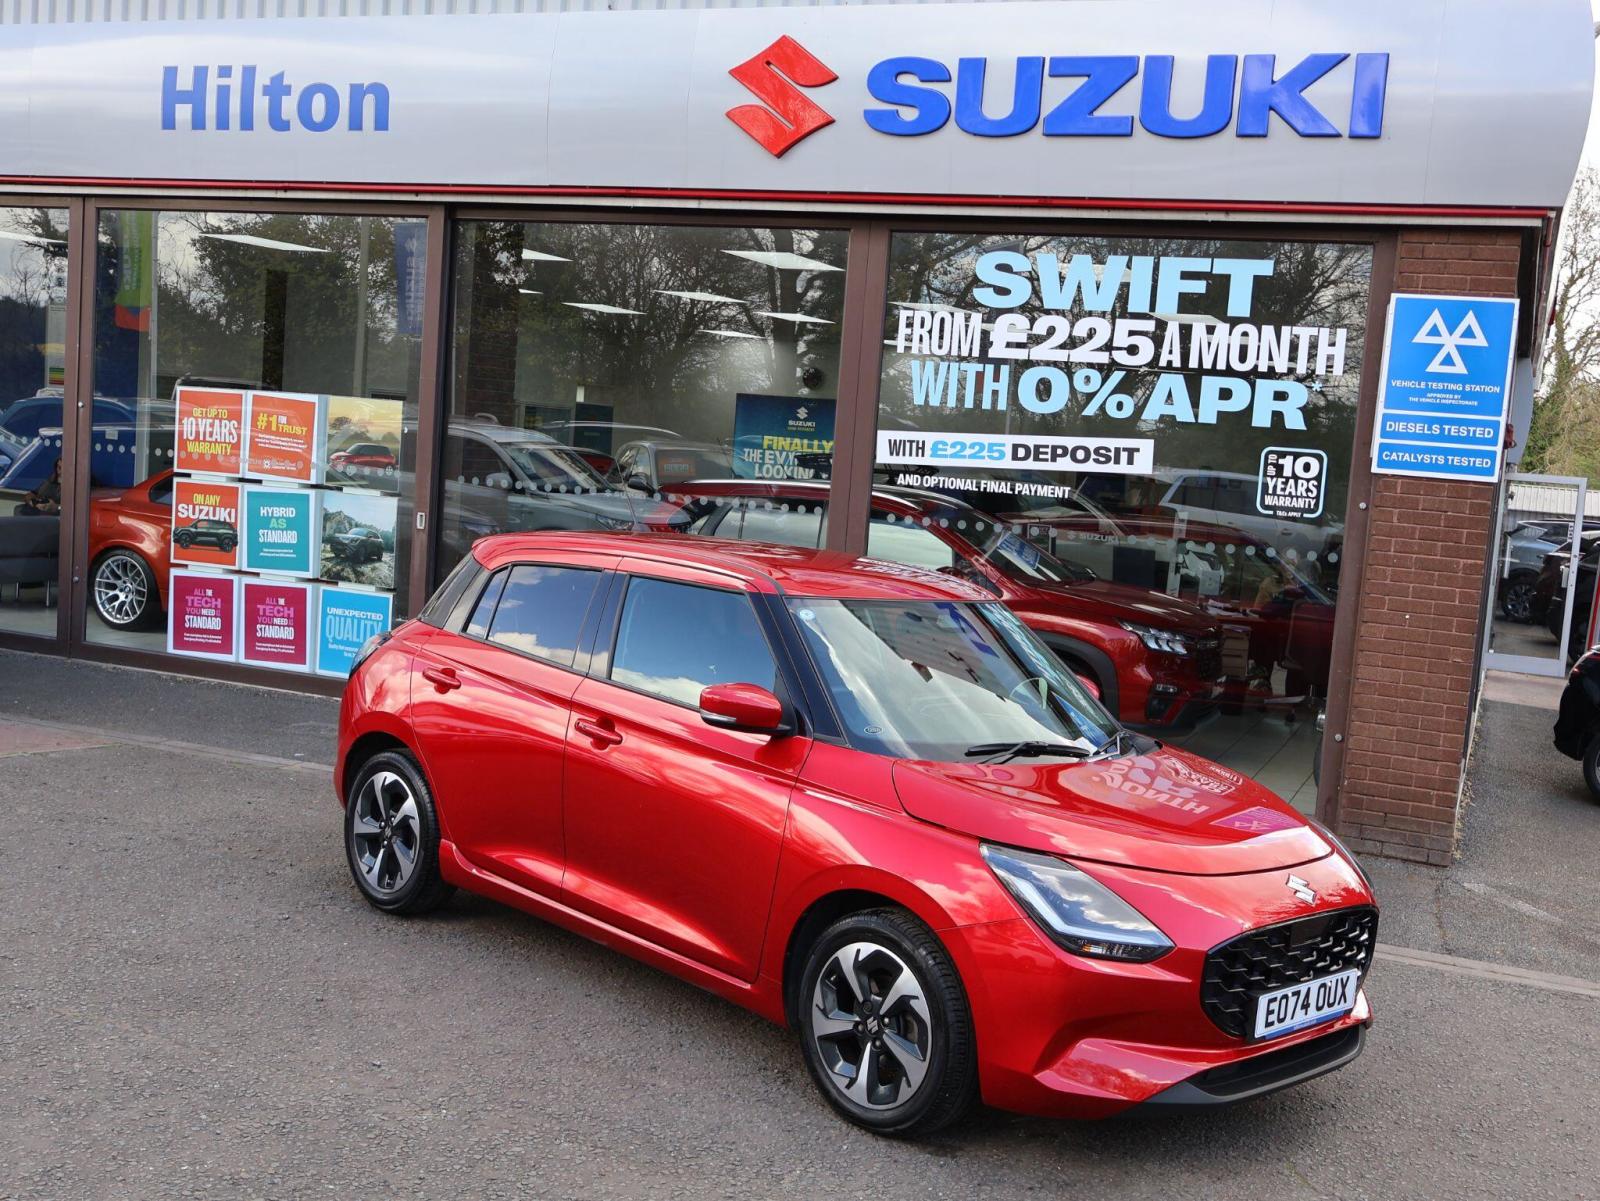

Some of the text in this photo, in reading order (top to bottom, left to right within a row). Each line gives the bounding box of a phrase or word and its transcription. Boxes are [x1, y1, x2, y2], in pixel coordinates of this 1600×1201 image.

[161, 65, 390, 132] Hilton
[863, 53, 1389, 138] SUZUKI
[973, 251, 1274, 317] SWIFT
[897, 310, 1347, 376] FROM £225 A MONTH
[911, 360, 1010, 411] WITH
[1017, 367, 1134, 419] 0%
[1391, 379, 1500, 393] VEHICLE TESTING STATION
[192, 407, 228, 419] GET UP TO
[182, 416, 196, 440] 10
[198, 418, 238, 444] YEARS
[256, 412, 277, 432] #1
[278, 424, 308, 436] TRUST
[788, 420, 816, 428] SUZUKI
[1386, 421, 1494, 439] DIESELS TESTED
[186, 440, 232, 456] WARRANTY
[763, 435, 834, 454] FINALLY
[888, 439, 1140, 466] WITH £225 DEPOSIT
[744, 448, 763, 463] THE
[1382, 451, 1491, 468] CATALYSTS TESTED
[1266, 453, 1277, 476] UP TO
[1278, 455, 1320, 479] 10
[897, 473, 1071, 499] AND OPTIONAL FINAL PAYMENT
[1266, 477, 1318, 498] YEARS
[193, 493, 221, 506] ON ANY
[1264, 494, 1316, 509] WARRANTY
[177, 503, 236, 523] SUZUKI
[260, 506, 296, 518] HYBRID
[269, 518, 287, 529] AS
[258, 530, 298, 544] STANDARD
[193, 588, 205, 596] ALL
[185, 596, 222, 608] TECH
[265, 597, 277, 605] ALL
[185, 607, 200, 615] YOU
[200, 608, 216, 616] NEED
[257, 604, 294, 618] TECH
[327, 607, 384, 621] UNEXPECTED
[184, 616, 222, 630] STANDARD
[257, 616, 273, 624] YOU
[273, 617, 289, 625] NEED
[325, 614, 383, 643] QUALITY
[256, 625, 295, 641] STANDARD
[1264, 976, 1350, 1029] EO74 OUX
